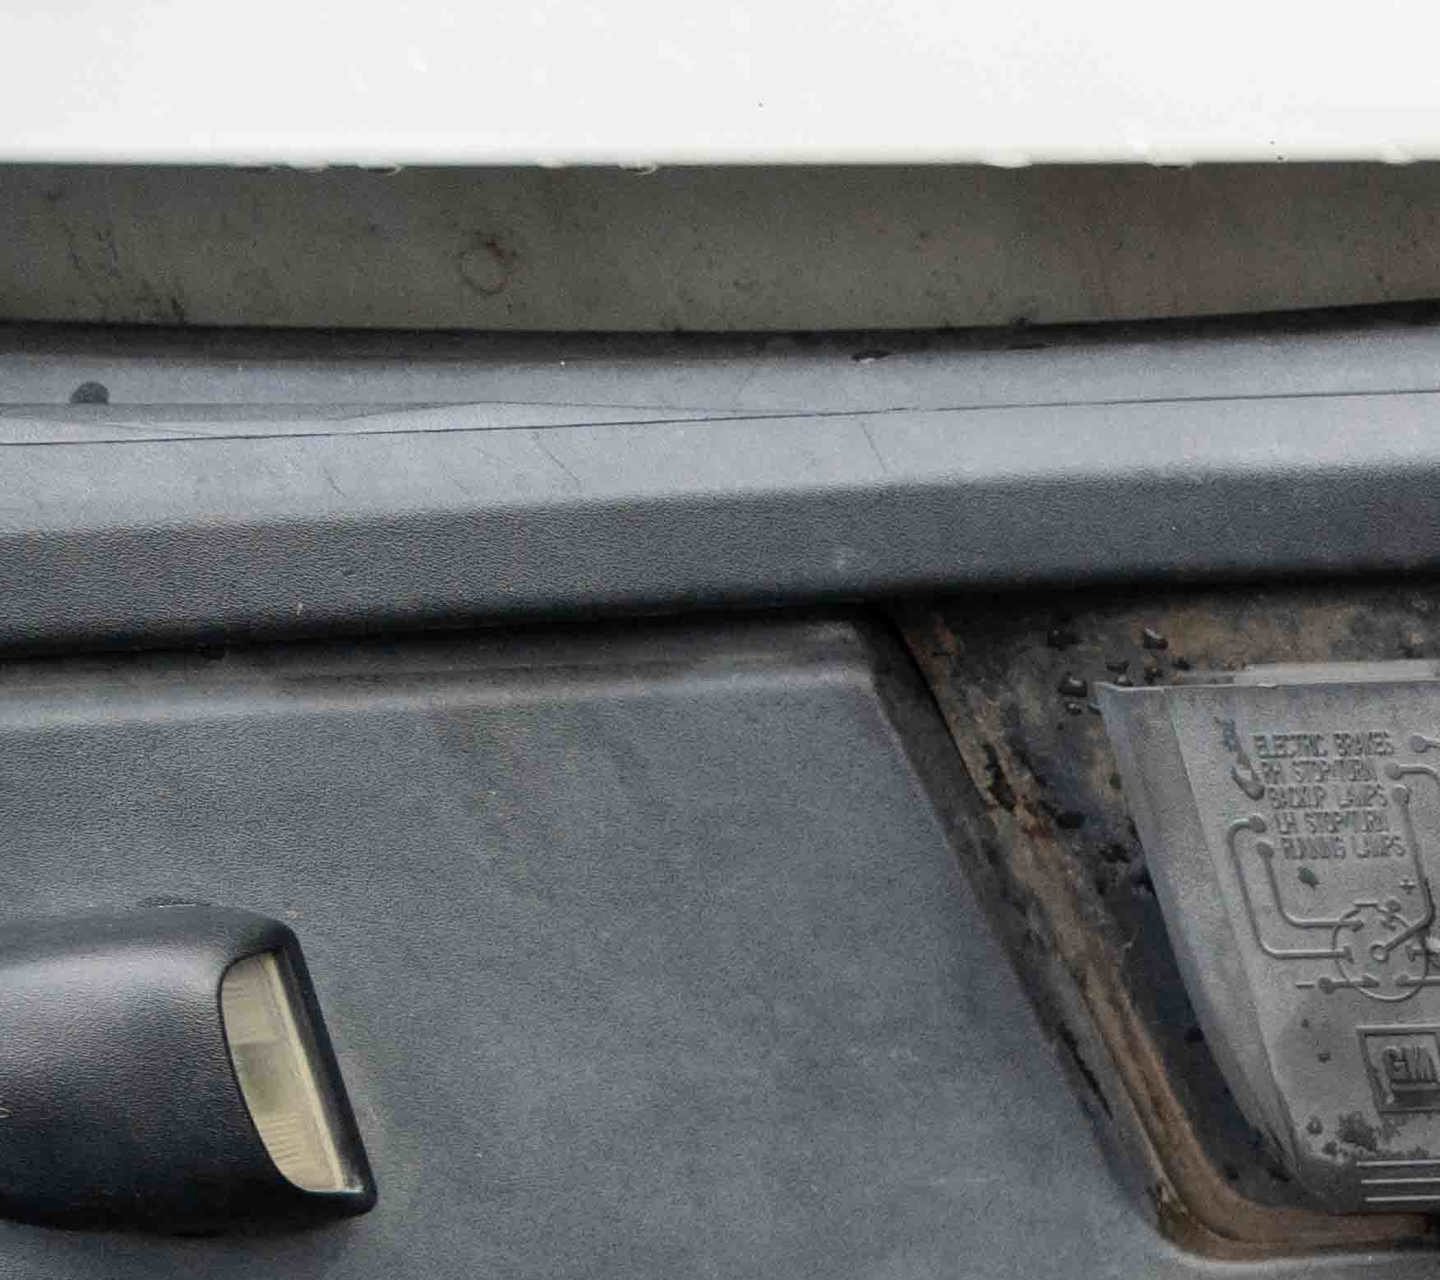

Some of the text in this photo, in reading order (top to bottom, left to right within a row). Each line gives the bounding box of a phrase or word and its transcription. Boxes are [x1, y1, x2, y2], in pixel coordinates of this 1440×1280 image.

[1251, 730, 1395, 759] ELECTRIC BRAKES
[1337, 783, 1389, 808] LAMPS
[1352, 833, 1406, 859] LAMPS
